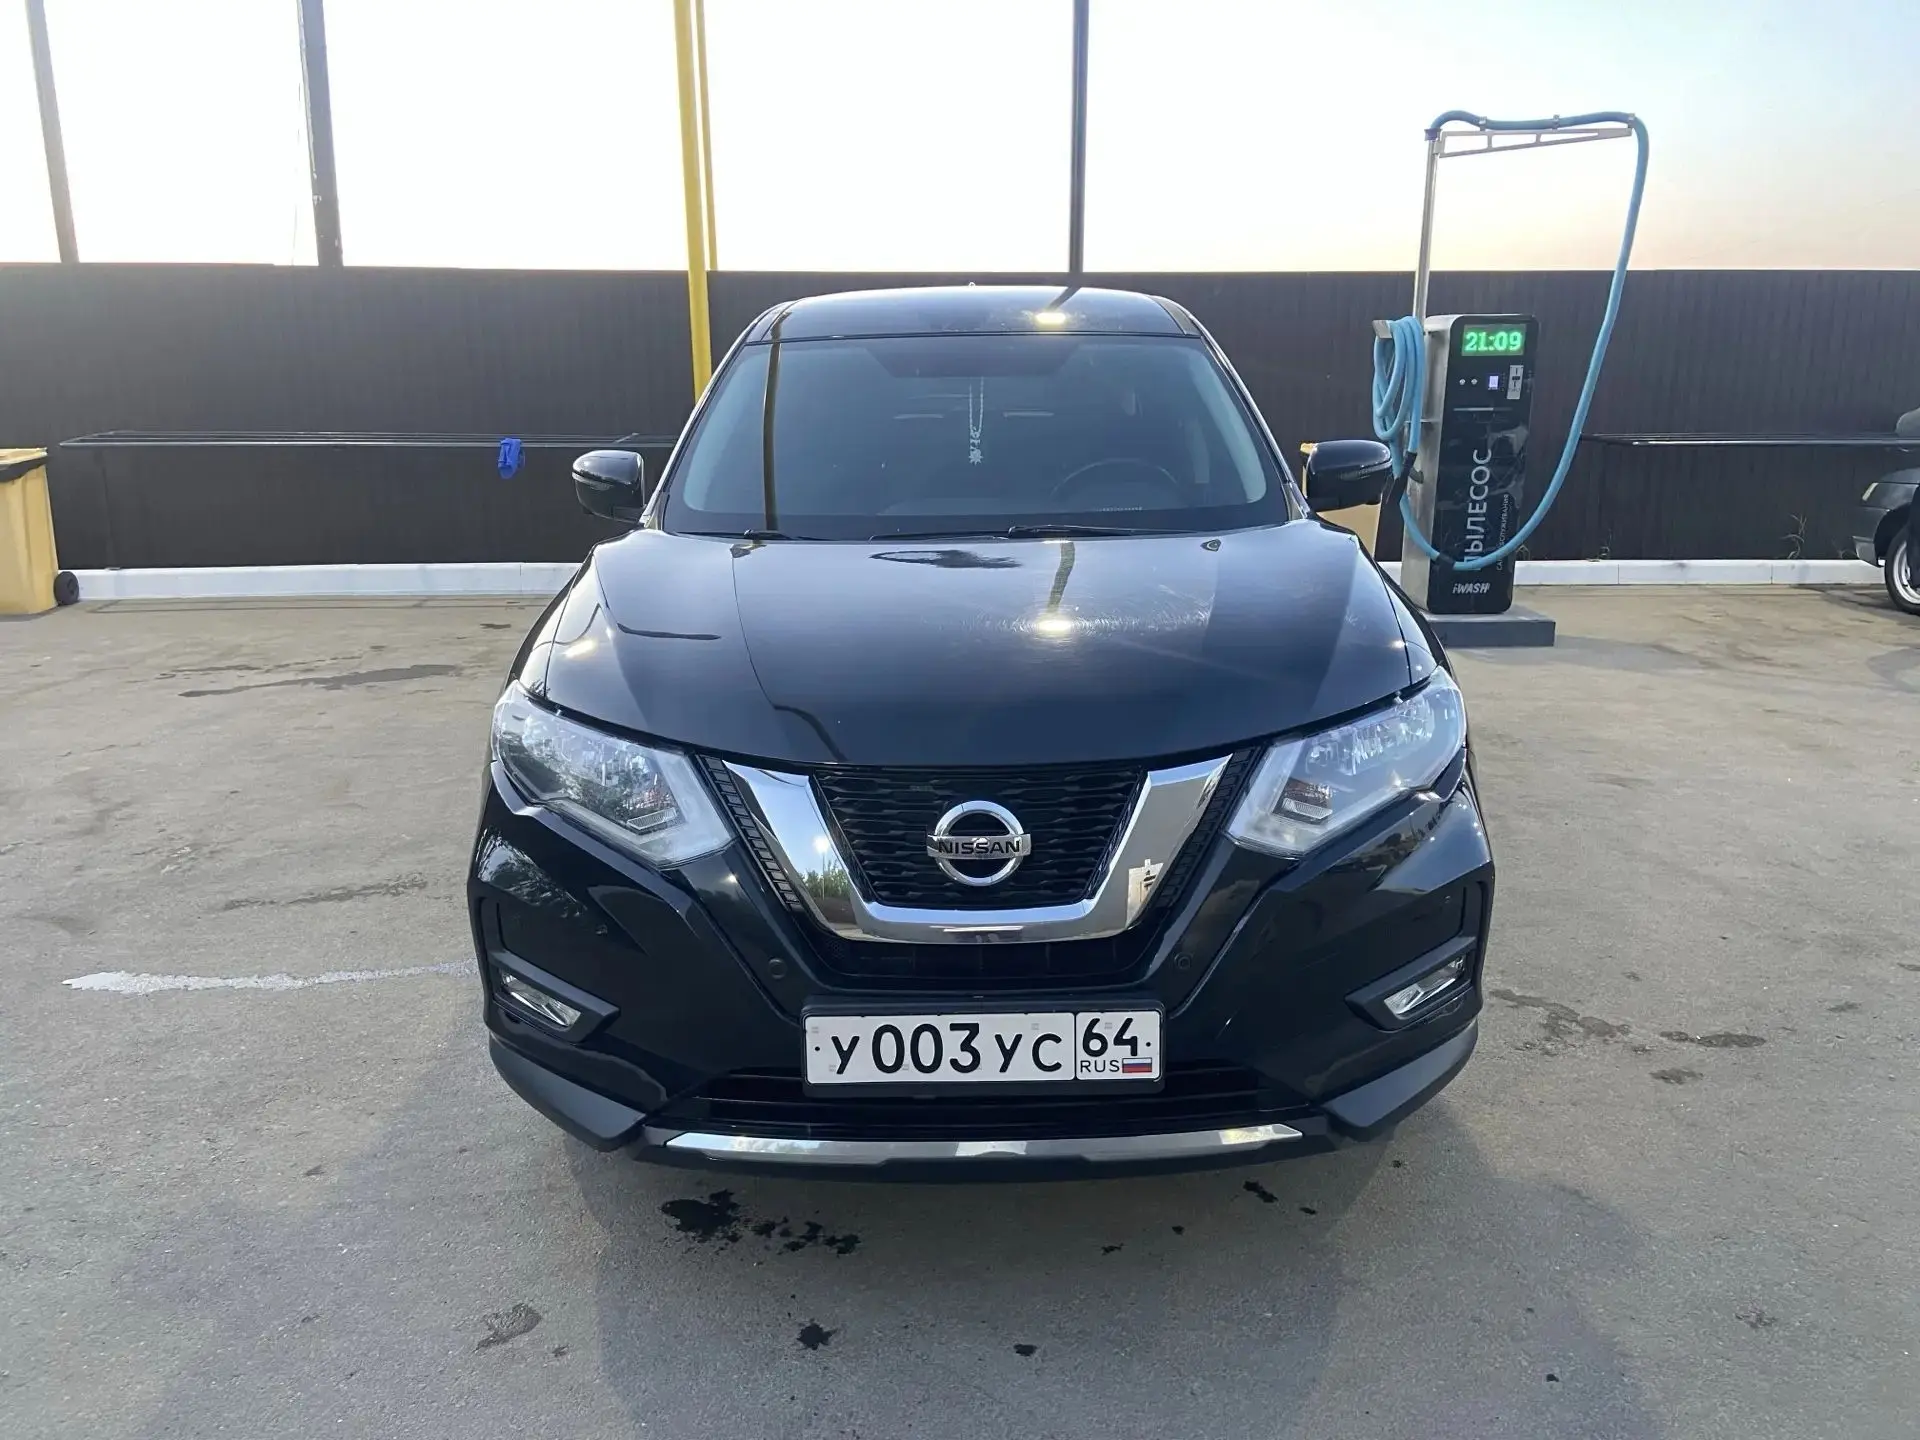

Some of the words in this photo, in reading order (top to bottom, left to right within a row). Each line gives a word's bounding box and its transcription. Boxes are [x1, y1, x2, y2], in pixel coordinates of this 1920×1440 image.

[1464, 331, 1522, 351] 21:09
[938, 840, 1020, 855] NISSAN
[1082, 1017, 1138, 1057] 64
[1080, 1060, 1120, 1073] RUS
